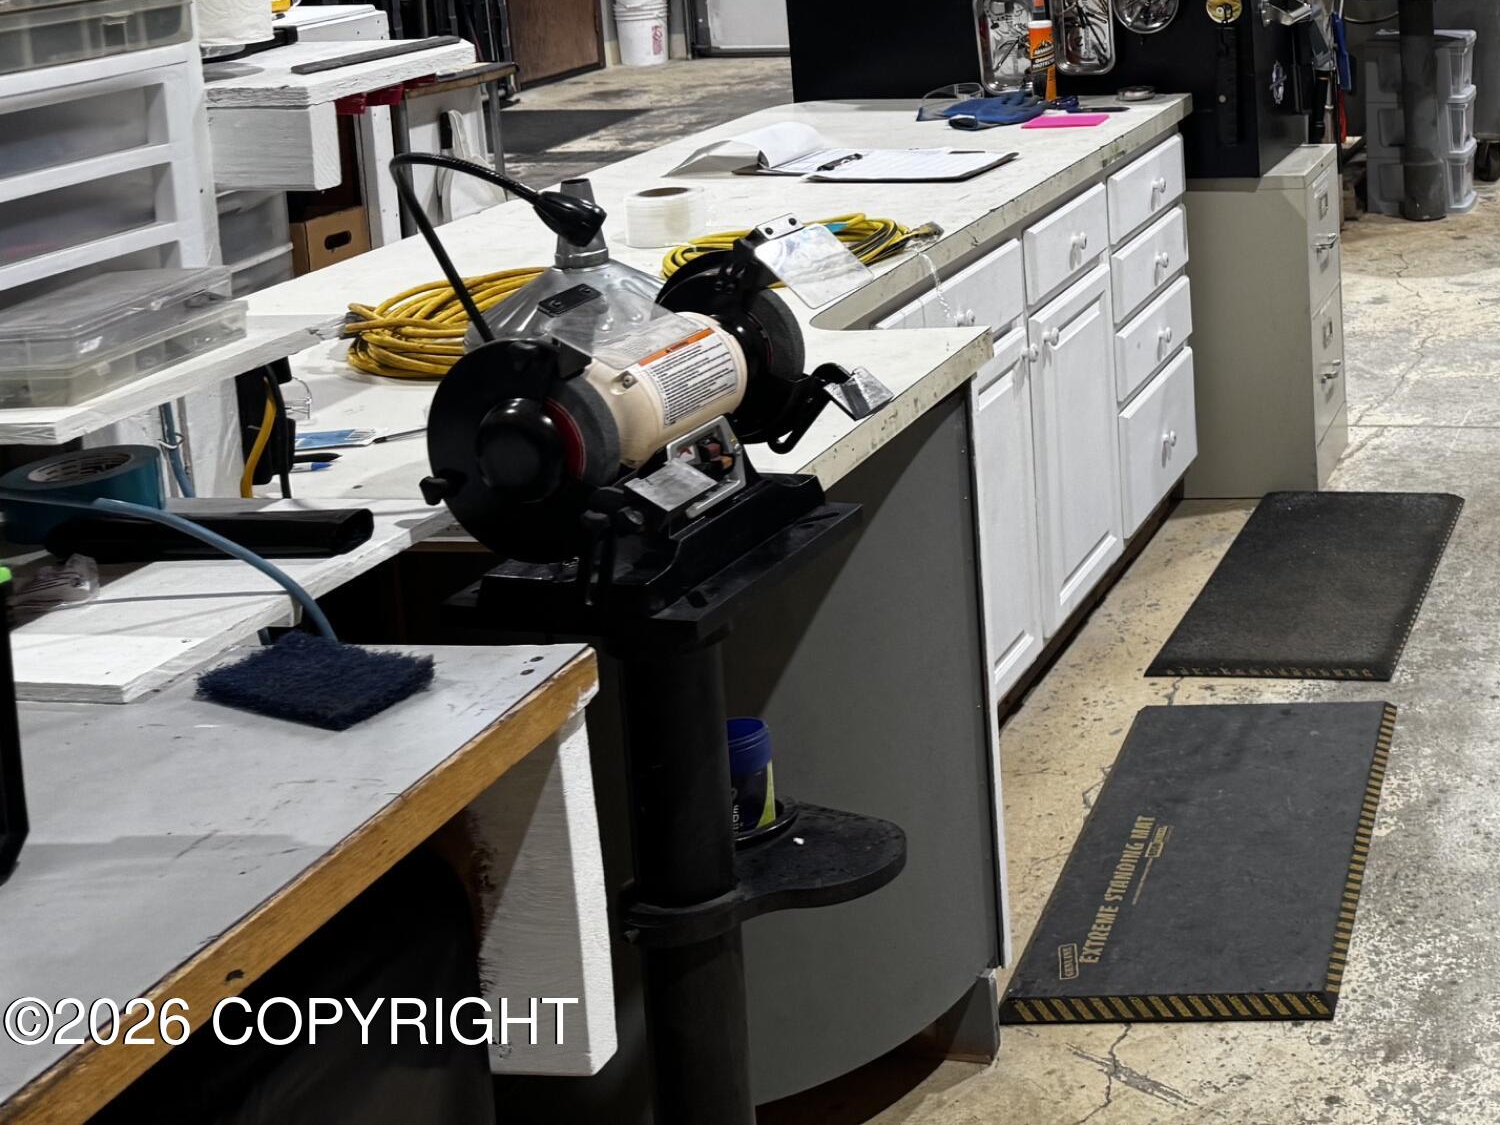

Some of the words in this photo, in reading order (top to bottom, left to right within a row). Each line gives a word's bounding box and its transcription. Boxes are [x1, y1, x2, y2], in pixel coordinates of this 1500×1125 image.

[1079, 905, 1120, 964] EXTREME
[1104, 843, 1145, 902] STANDING
[1130, 815, 1156, 840] MAT
